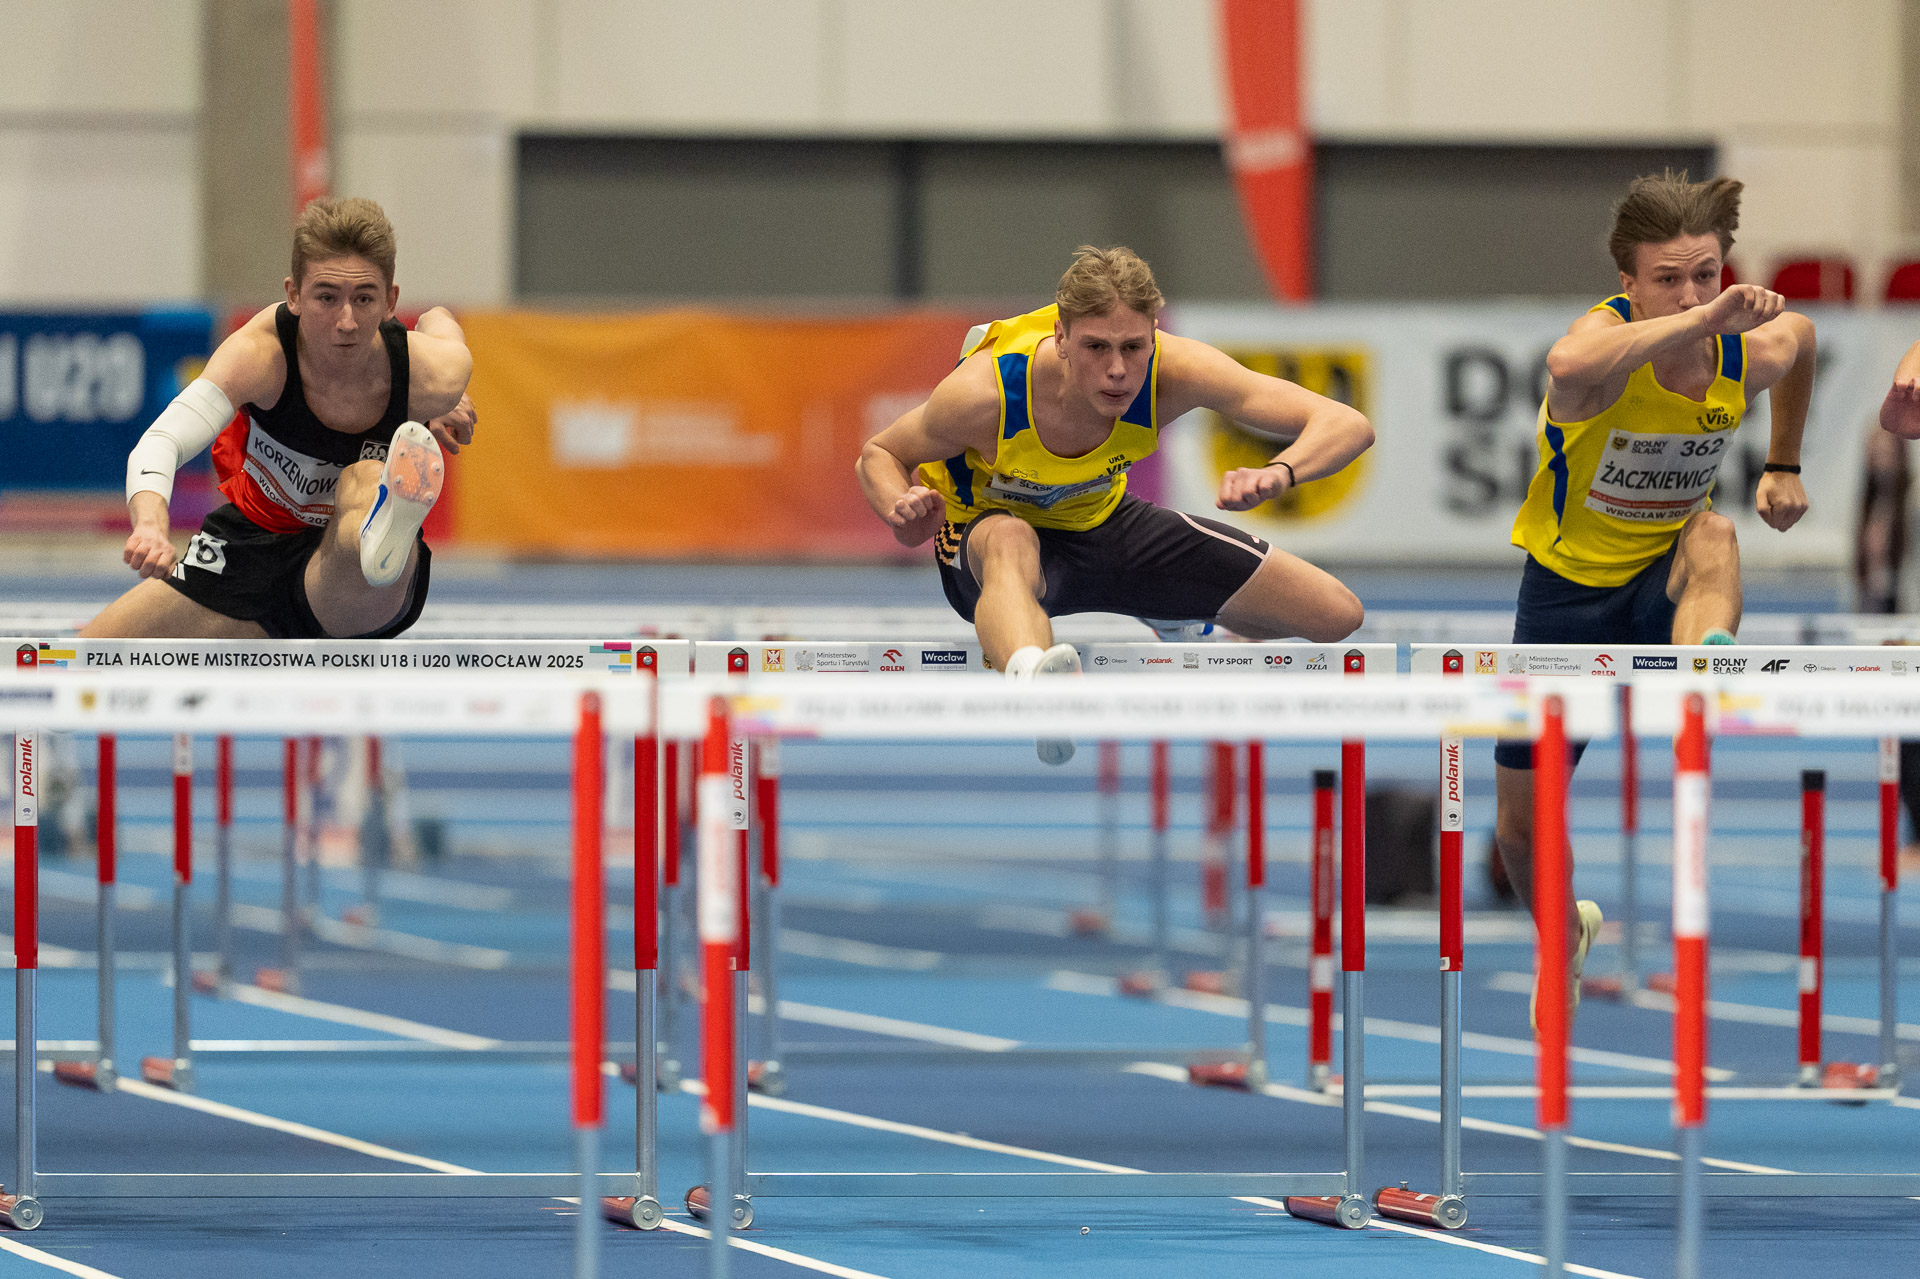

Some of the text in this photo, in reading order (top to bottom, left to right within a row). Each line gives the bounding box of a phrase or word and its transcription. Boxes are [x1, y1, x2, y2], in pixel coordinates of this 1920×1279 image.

[1706, 413, 1729, 425] VIS
[1680, 438, 1724, 457] 362
[254, 437, 338, 496] KORZENIOW
[1600, 461, 1717, 489] ŻACZKIEWICZ
[1605, 506, 1667, 519] WROCŁAW
[308, 516, 329, 525] 202
[87, 652, 584, 668] PZLA HALOWE MISTRZOSTWA POLSKI U18 i U20 WROCŁAW 2025
[816, 659, 837, 667] Sportu
[842, 659, 870, 667] Turystyki
[924, 653, 965, 662] Wrocław
[1146, 657, 1173, 665] polanik
[1635, 658, 1675, 667] Wrocław
[1713, 658, 1748, 666] DOLNY
[1529, 663, 1549, 671] Sportu
[1554, 663, 1581, 671] Turystyki
[19, 737, 35, 797] polanik
[730, 741, 746, 801] polanik
[1446, 743, 1461, 803] polanik
